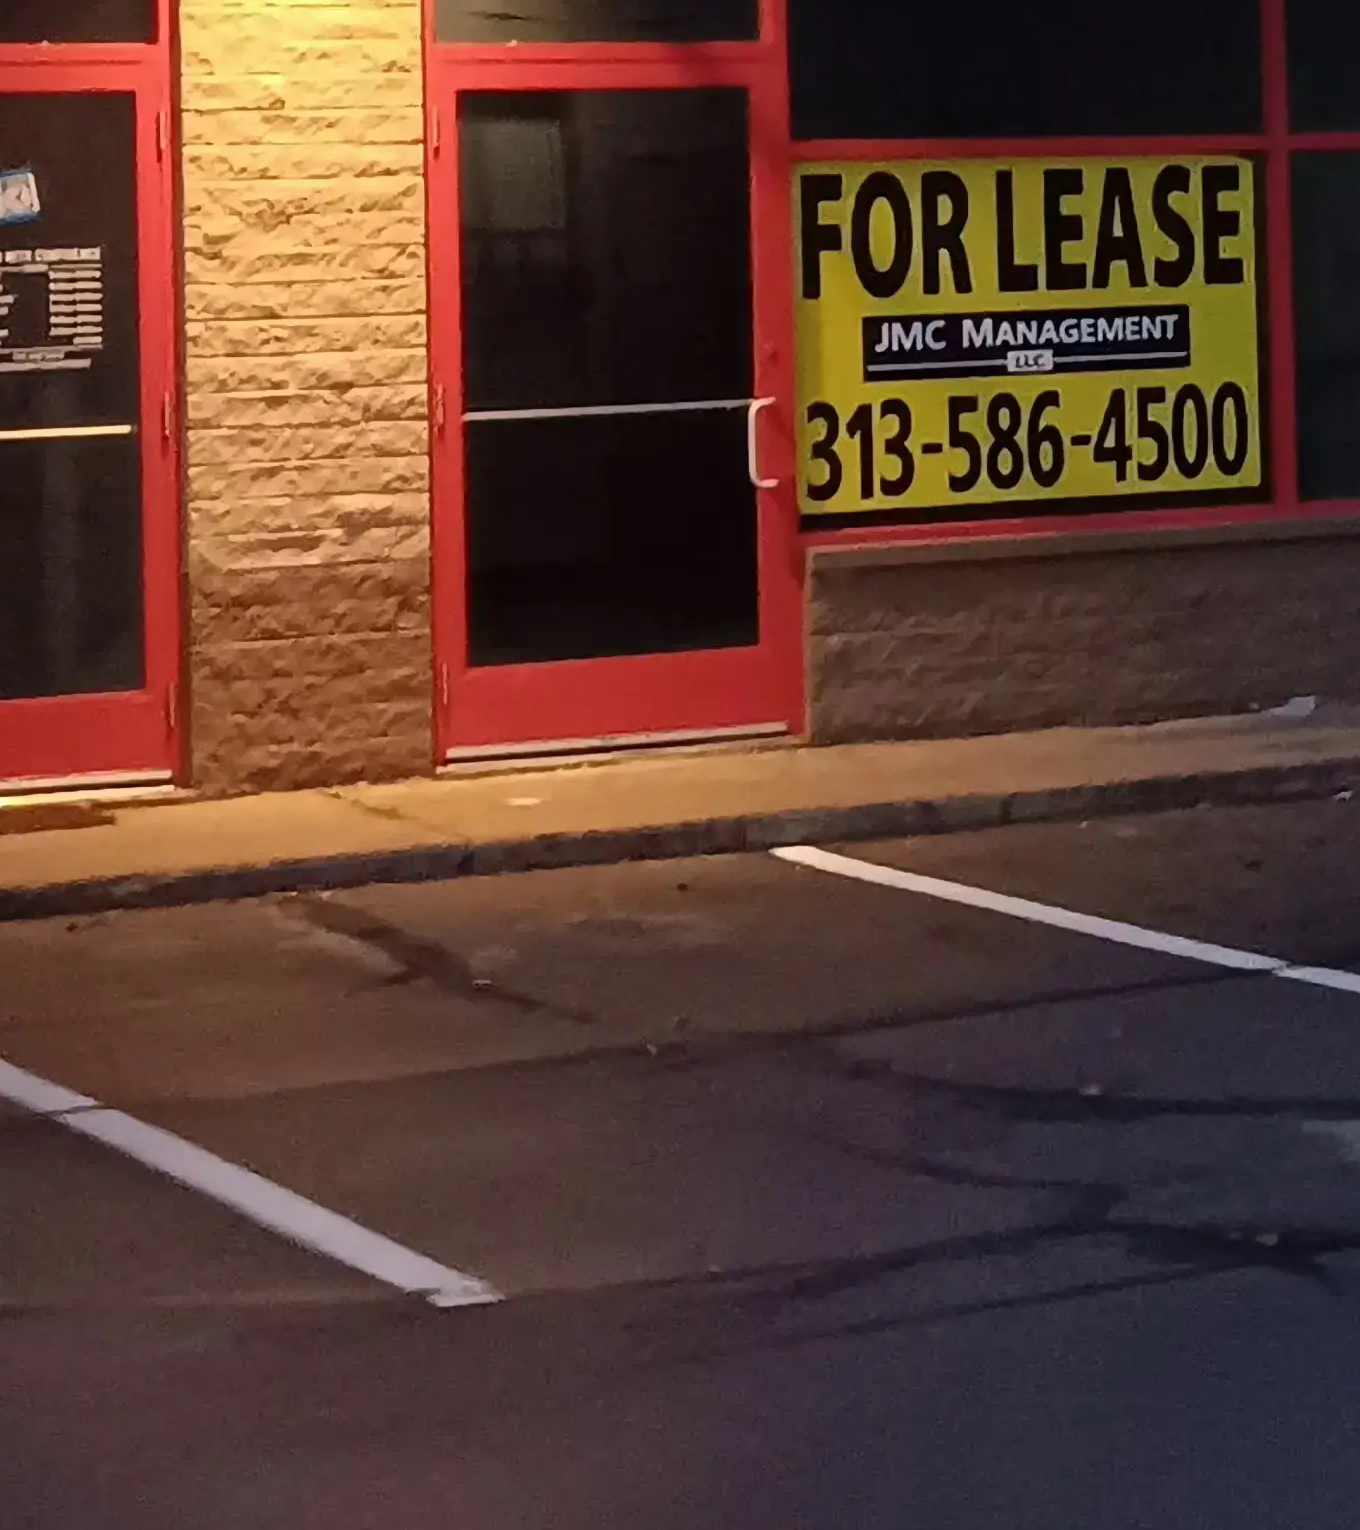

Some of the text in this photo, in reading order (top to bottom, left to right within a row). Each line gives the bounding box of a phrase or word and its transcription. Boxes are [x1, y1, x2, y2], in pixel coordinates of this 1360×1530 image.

[799, 165, 1244, 300] FOR LEASE
[874, 314, 1179, 353] JMC MANAGEMENT
[1014, 352, 1047, 369] LLC
[805, 381, 1248, 502] 313-586-4500
